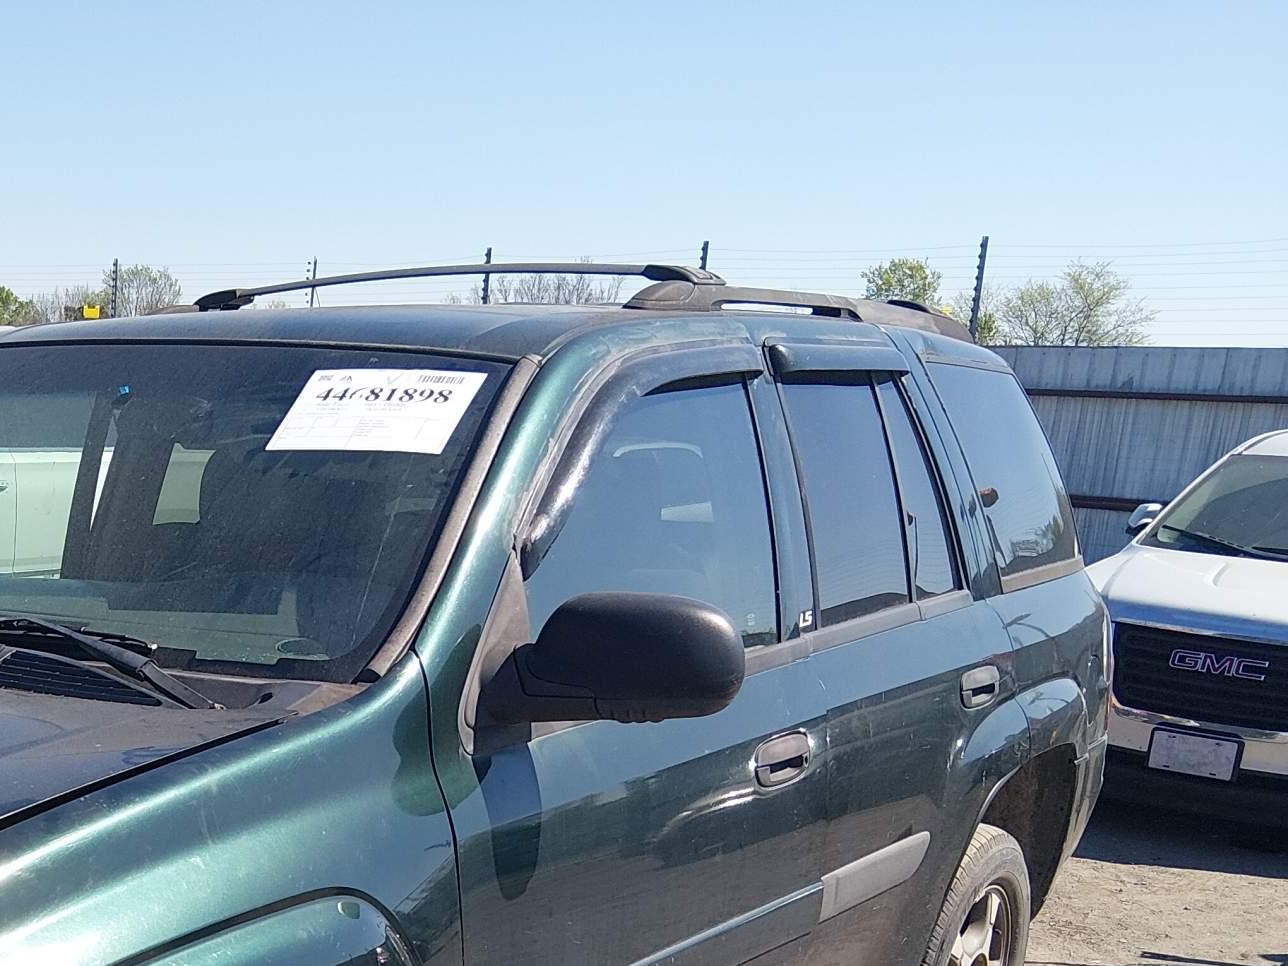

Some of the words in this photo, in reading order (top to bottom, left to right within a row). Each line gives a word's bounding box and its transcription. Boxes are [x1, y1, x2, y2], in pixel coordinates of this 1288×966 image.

[316, 387, 453, 403] 44681898
[799, 611, 813, 627] LS
[1169, 649, 1269, 681] GMC
